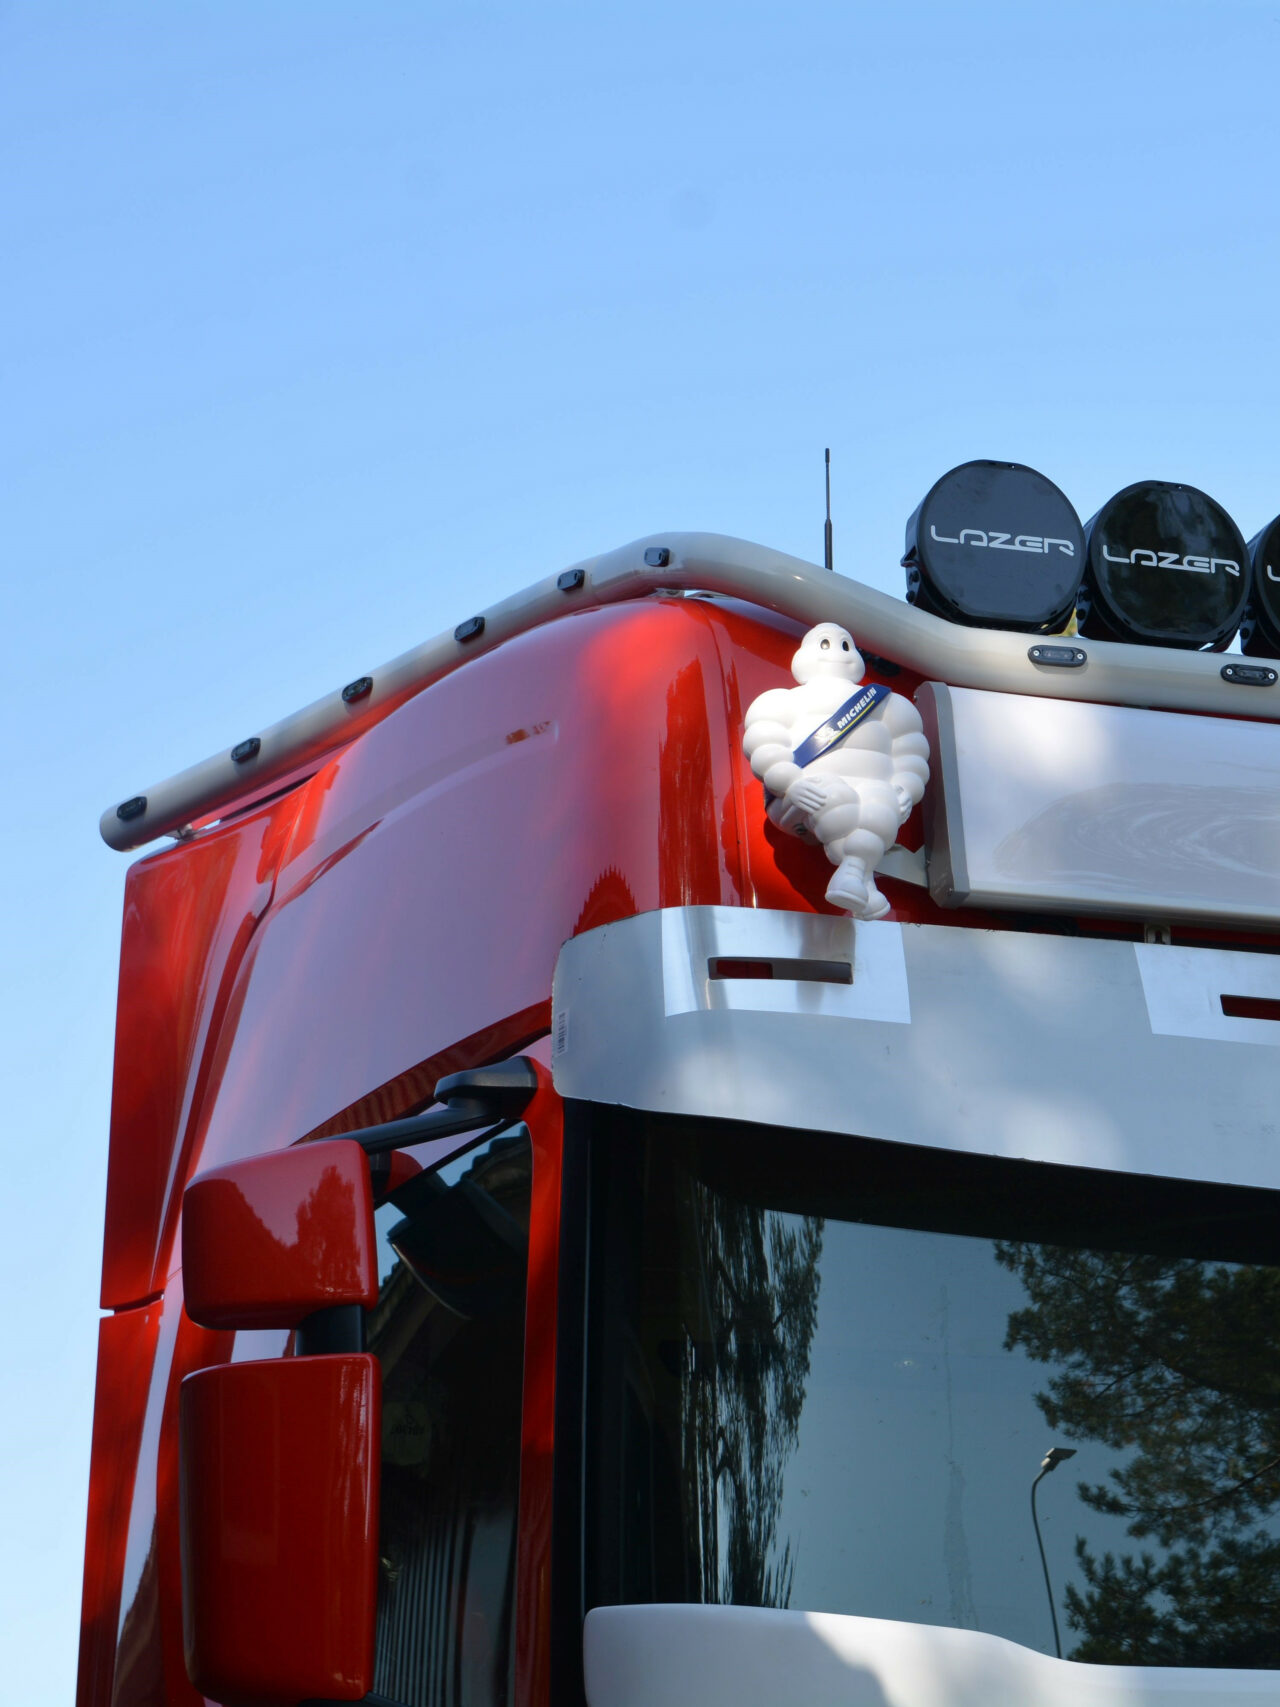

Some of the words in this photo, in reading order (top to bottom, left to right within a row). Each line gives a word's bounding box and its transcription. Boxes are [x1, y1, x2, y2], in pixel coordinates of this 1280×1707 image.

[930, 525, 1074, 556] LAZER
[1103, 545, 1240, 576] LAZER
[837, 687, 877, 729] MICHELIN
